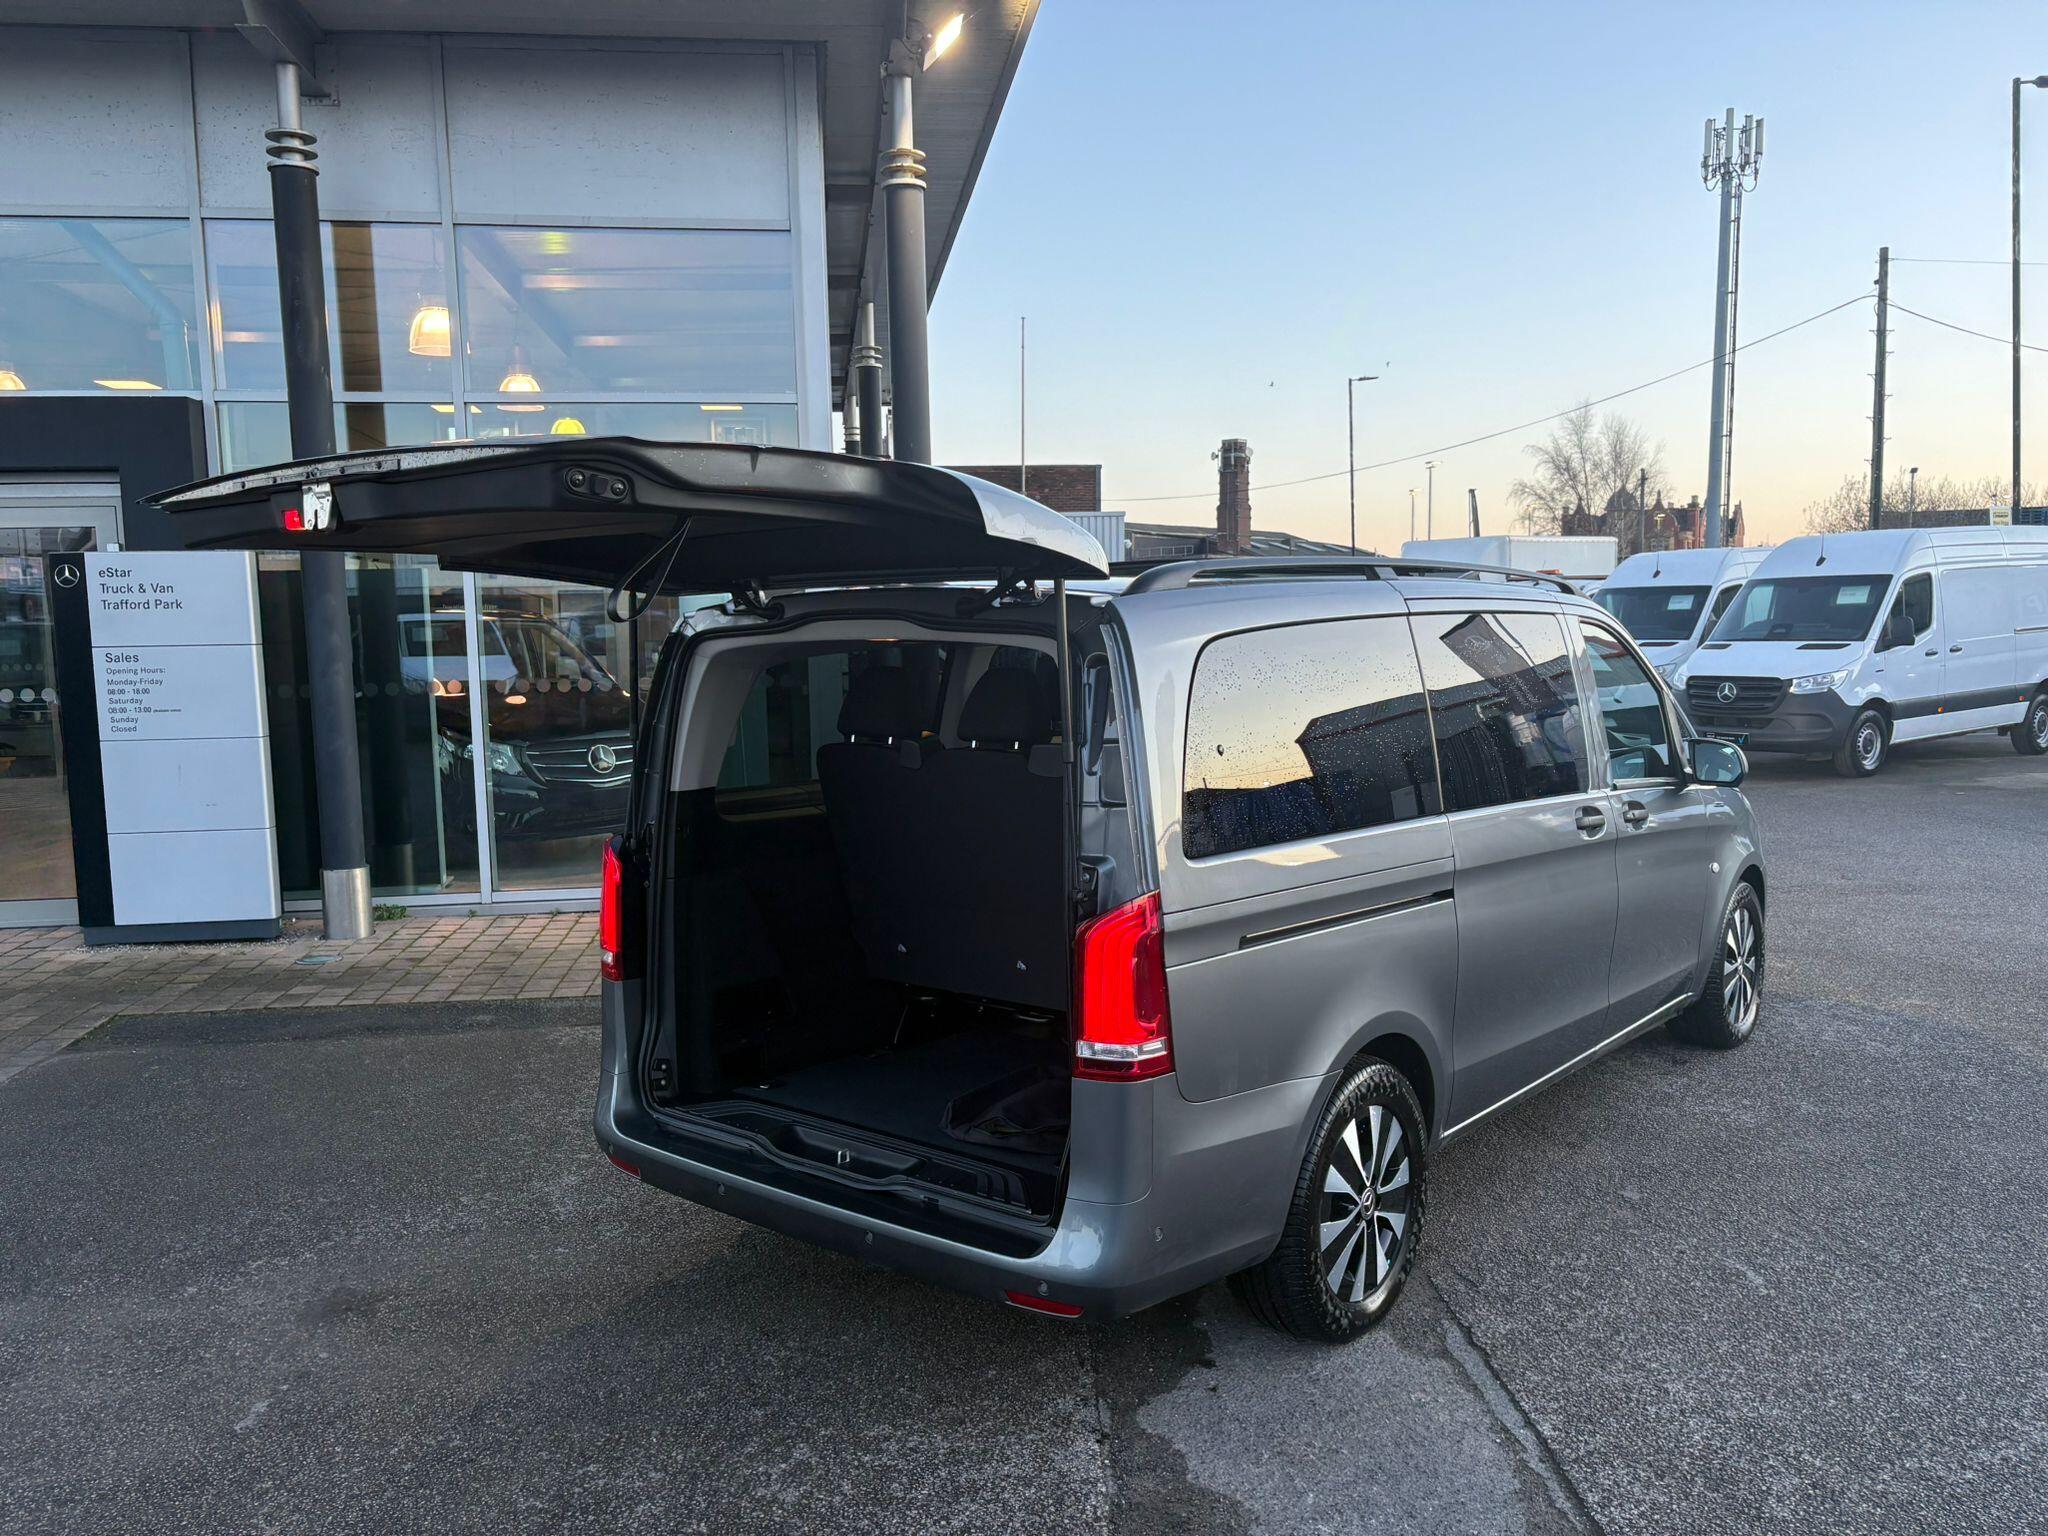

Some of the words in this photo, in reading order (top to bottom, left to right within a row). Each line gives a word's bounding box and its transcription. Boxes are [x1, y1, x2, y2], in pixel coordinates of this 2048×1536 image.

[98, 567, 133, 578] eStar
[99, 583, 135, 594] Truck
[138, 583, 147, 594] &
[150, 582, 174, 594] Van
[101, 599, 151, 610] Trafford
[154, 598, 183, 610] Park
[105, 652, 140, 663] Sales
[106, 667, 139, 676] Opening
[140, 666, 166, 674] Hours:
[132, 687, 151, 695] 18:00
[108, 697, 144, 706] Saturday
[107, 706, 128, 714] 08:00
[134, 706, 152, 714] 13:00
[110, 716, 139, 725] Sunday
[110, 725, 138, 733] Closed
